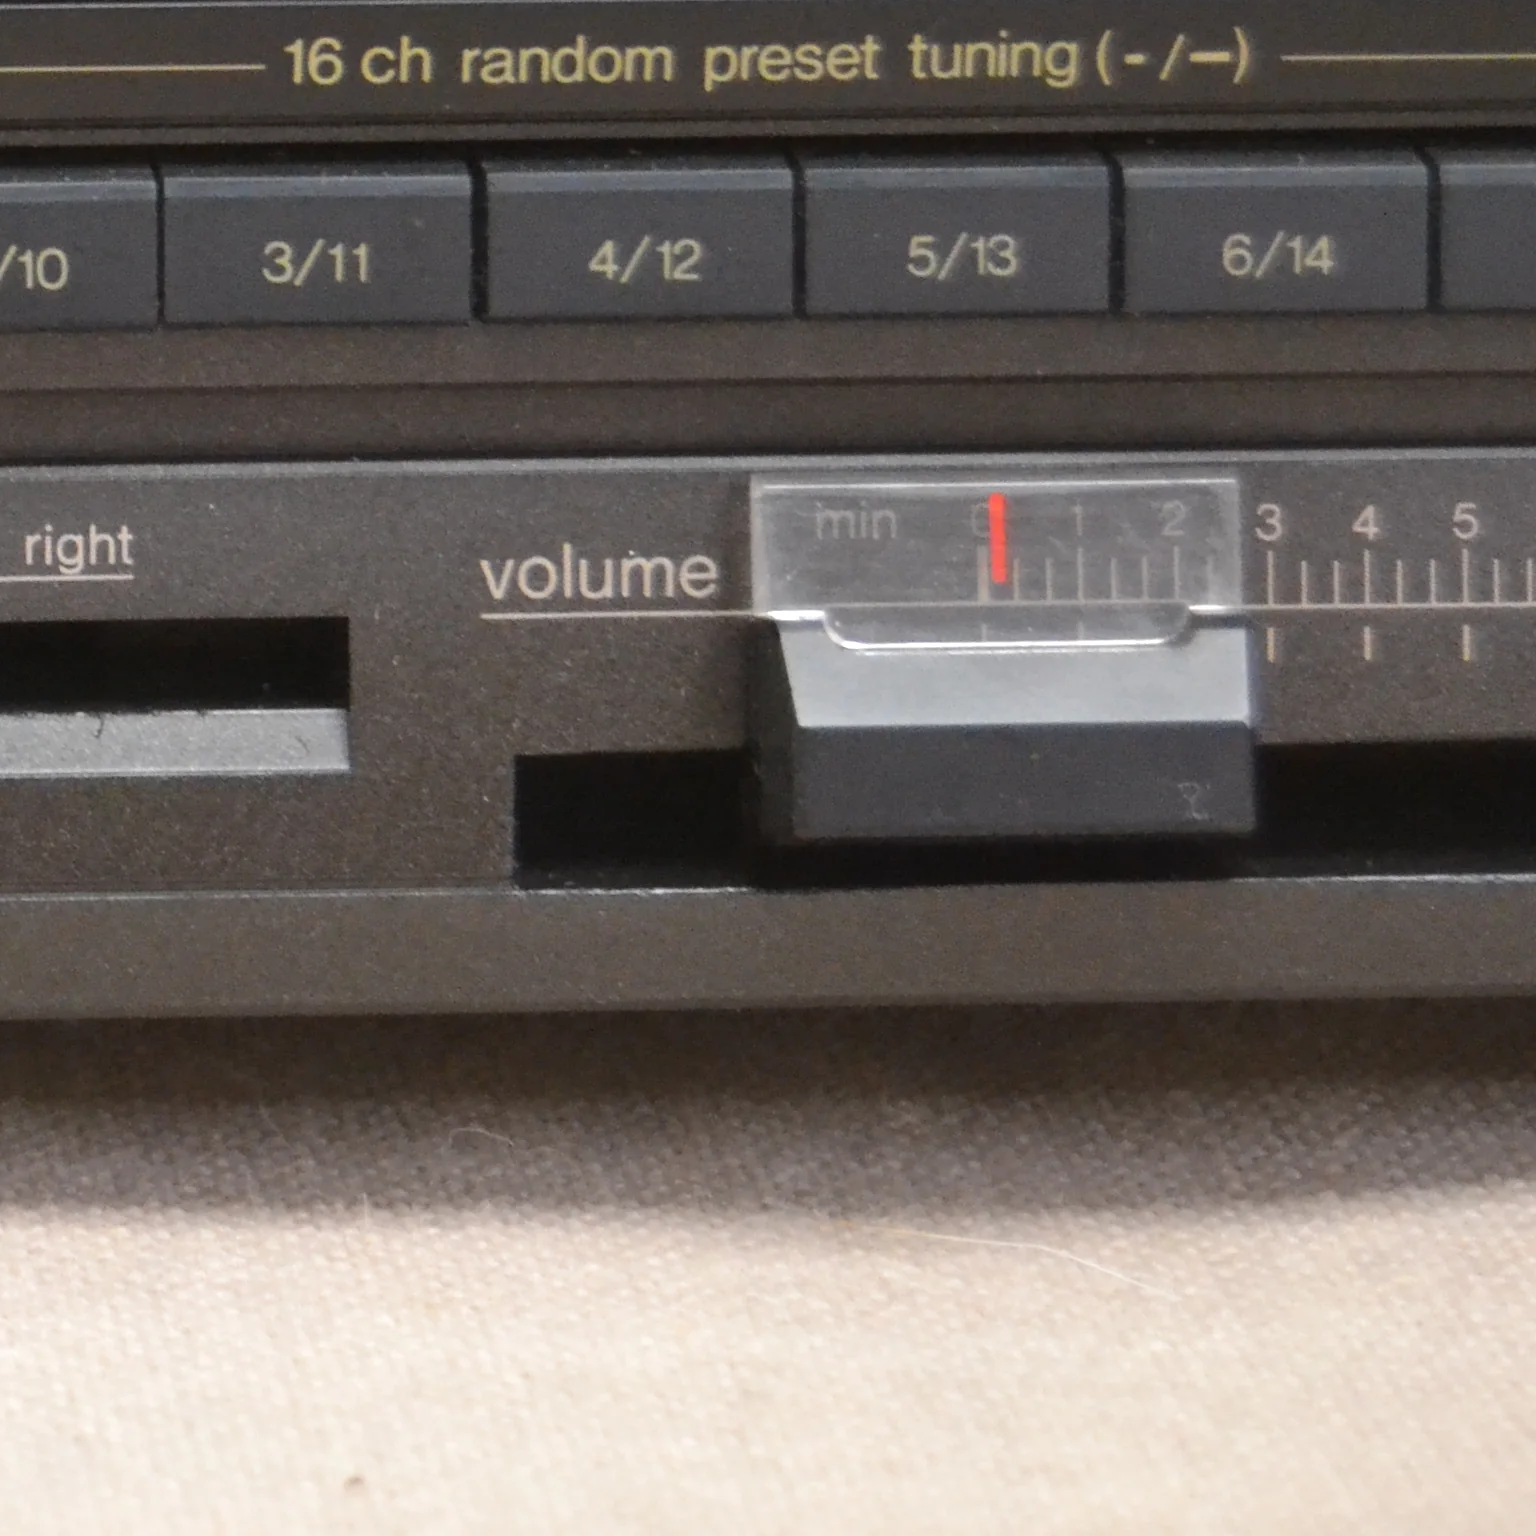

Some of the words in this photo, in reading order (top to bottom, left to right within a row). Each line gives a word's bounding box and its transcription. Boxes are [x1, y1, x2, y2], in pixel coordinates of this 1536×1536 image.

[284, 36, 344, 85] 16
[360, 35, 432, 85] ch
[461, 34, 674, 85] random
[703, 34, 881, 92] preset
[262, 238, 369, 287] 3/11
[588, 235, 703, 283] 4/12
[907, 232, 1019, 280] 5/13
[1222, 231, 1335, 278] 6/14
[815, 500, 898, 540] min
[1159, 498, 1186, 537] 2
[1255, 503, 1284, 542] 3
[1352, 505, 1381, 541] 4
[1452, 502, 1480, 540] 5
[24, 524, 134, 576] right
[479, 542, 718, 600] volume
